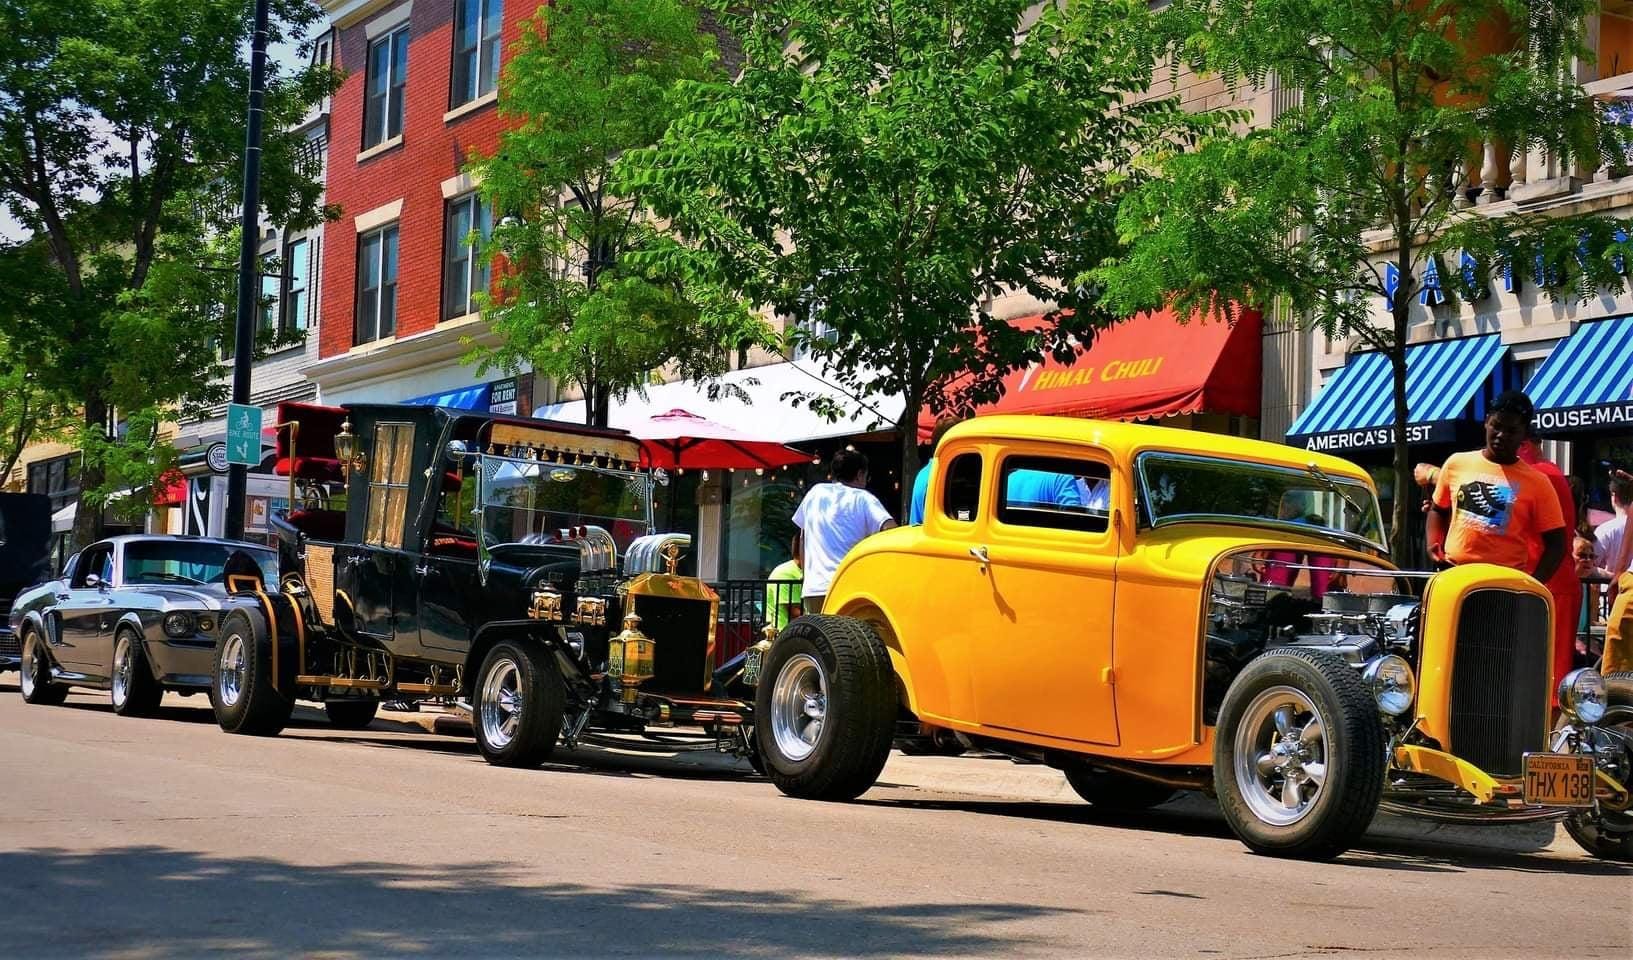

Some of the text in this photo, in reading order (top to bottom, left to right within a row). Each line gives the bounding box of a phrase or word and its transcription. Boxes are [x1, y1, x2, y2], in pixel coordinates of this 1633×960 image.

[1032, 357, 1164, 391] HIMAL CHULI
[491, 388, 515, 404] FOR RENT
[228, 430, 260, 440] BIKE ROUTE
[1306, 429, 1388, 451] AMERICA'S
[1528, 760, 1570, 770] CALIFORNIA
[1528, 771, 1590, 799] THX 138
